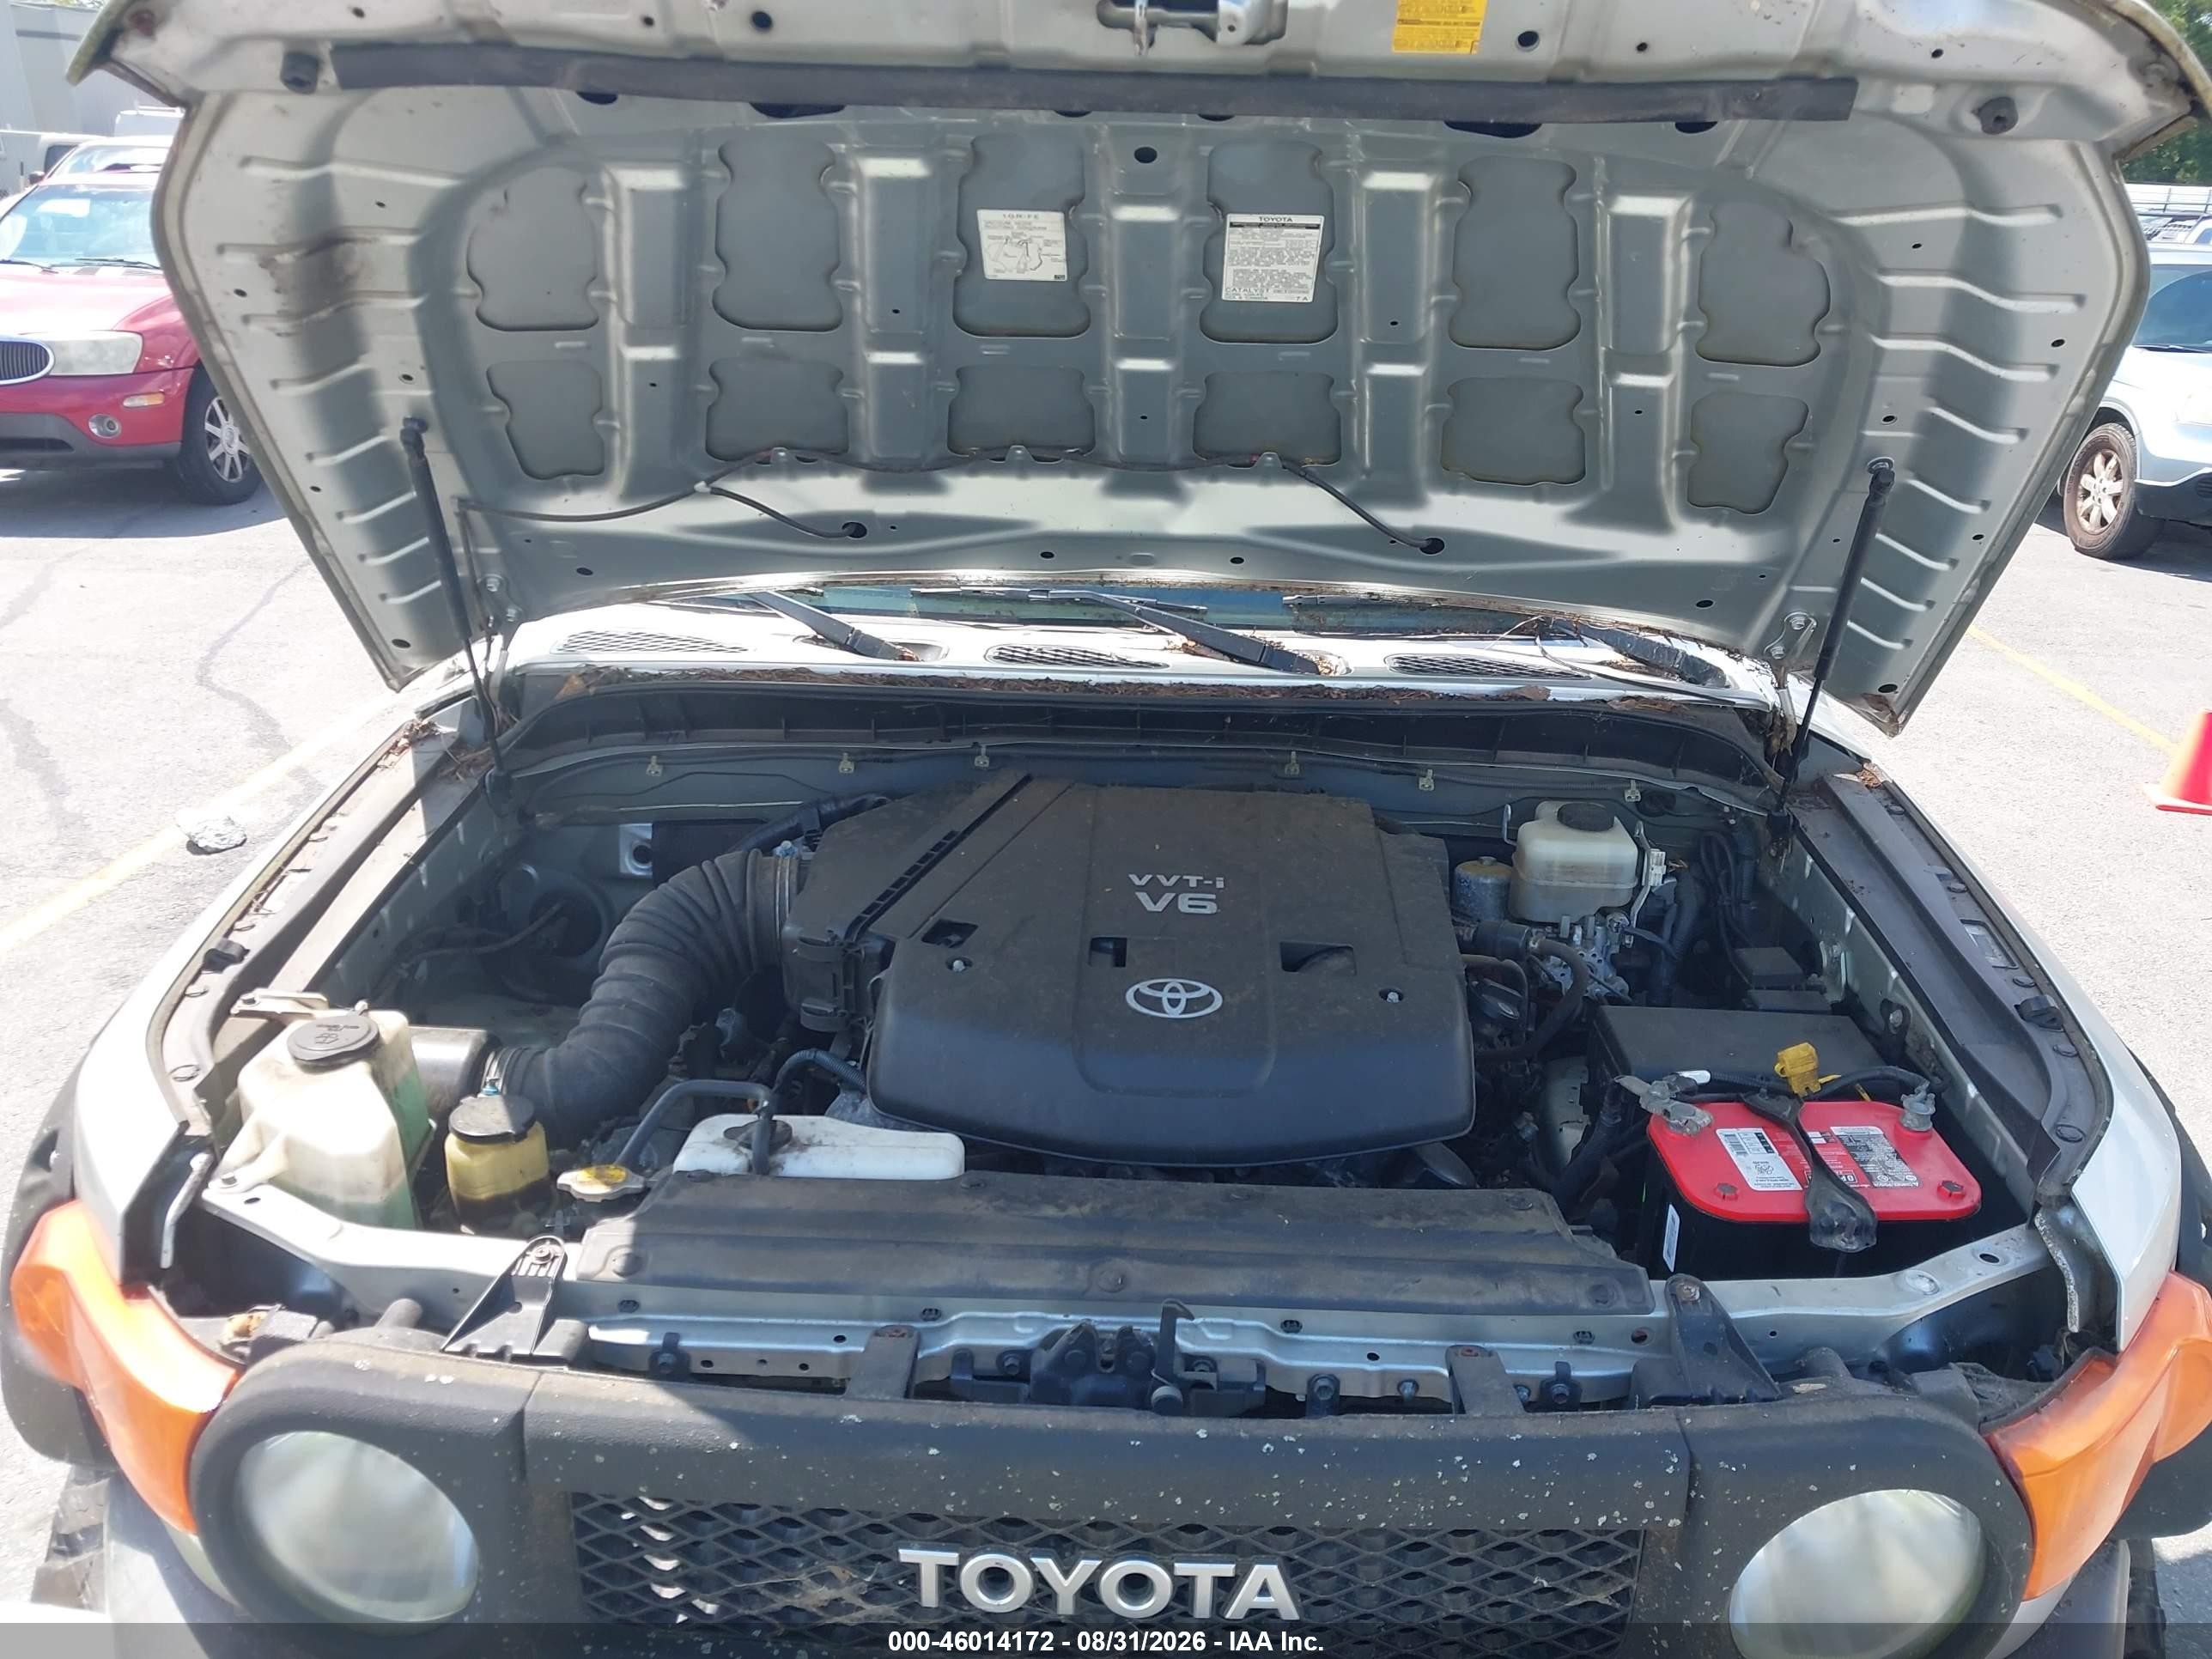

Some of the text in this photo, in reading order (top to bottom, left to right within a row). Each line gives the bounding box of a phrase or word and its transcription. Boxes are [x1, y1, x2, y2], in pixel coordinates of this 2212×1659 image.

[1128, 873, 1224, 888] VVT-i
[1135, 891, 1218, 915] V6
[897, 1548, 1301, 1620] TOYOTA
